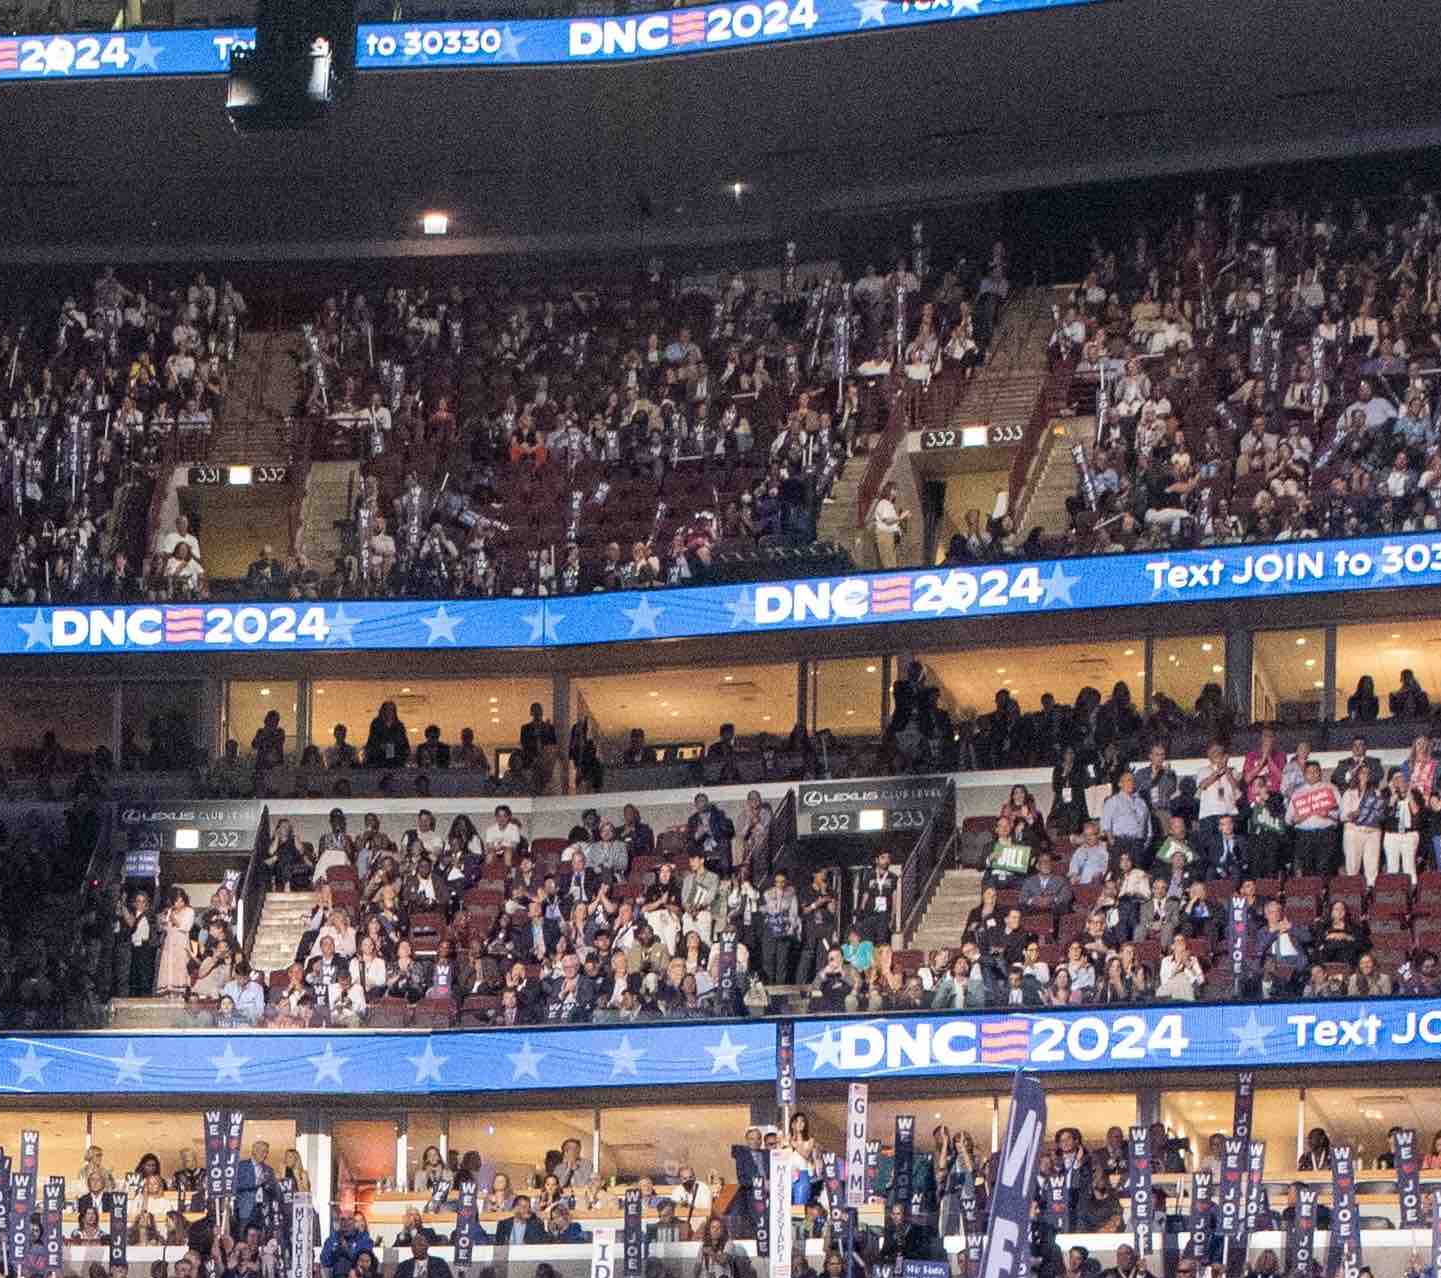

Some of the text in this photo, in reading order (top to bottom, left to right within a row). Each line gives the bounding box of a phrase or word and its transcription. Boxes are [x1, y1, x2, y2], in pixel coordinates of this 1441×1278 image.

[366, 29, 501, 57] to 30330
[568, 2, 818, 57] DNC 2024
[19, 37, 129, 73] 2024
[926, 426, 1024, 447] 332 333
[197, 467, 286, 482] 331 332
[1146, 560, 1224, 590] Text
[1232, 549, 1323, 583] JOIN
[1335, 549, 1372, 577] to
[755, 566, 1042, 624] DNC 2024
[52, 606, 330, 645] DNC 2024
[209, 832, 239, 848] 232
[818, 815, 850, 831] 232
[839, 1016, 1189, 1069] DNC 2024
[1287, 1014, 1381, 1047] Text
[850, 1098, 865, 1194] GUAM
